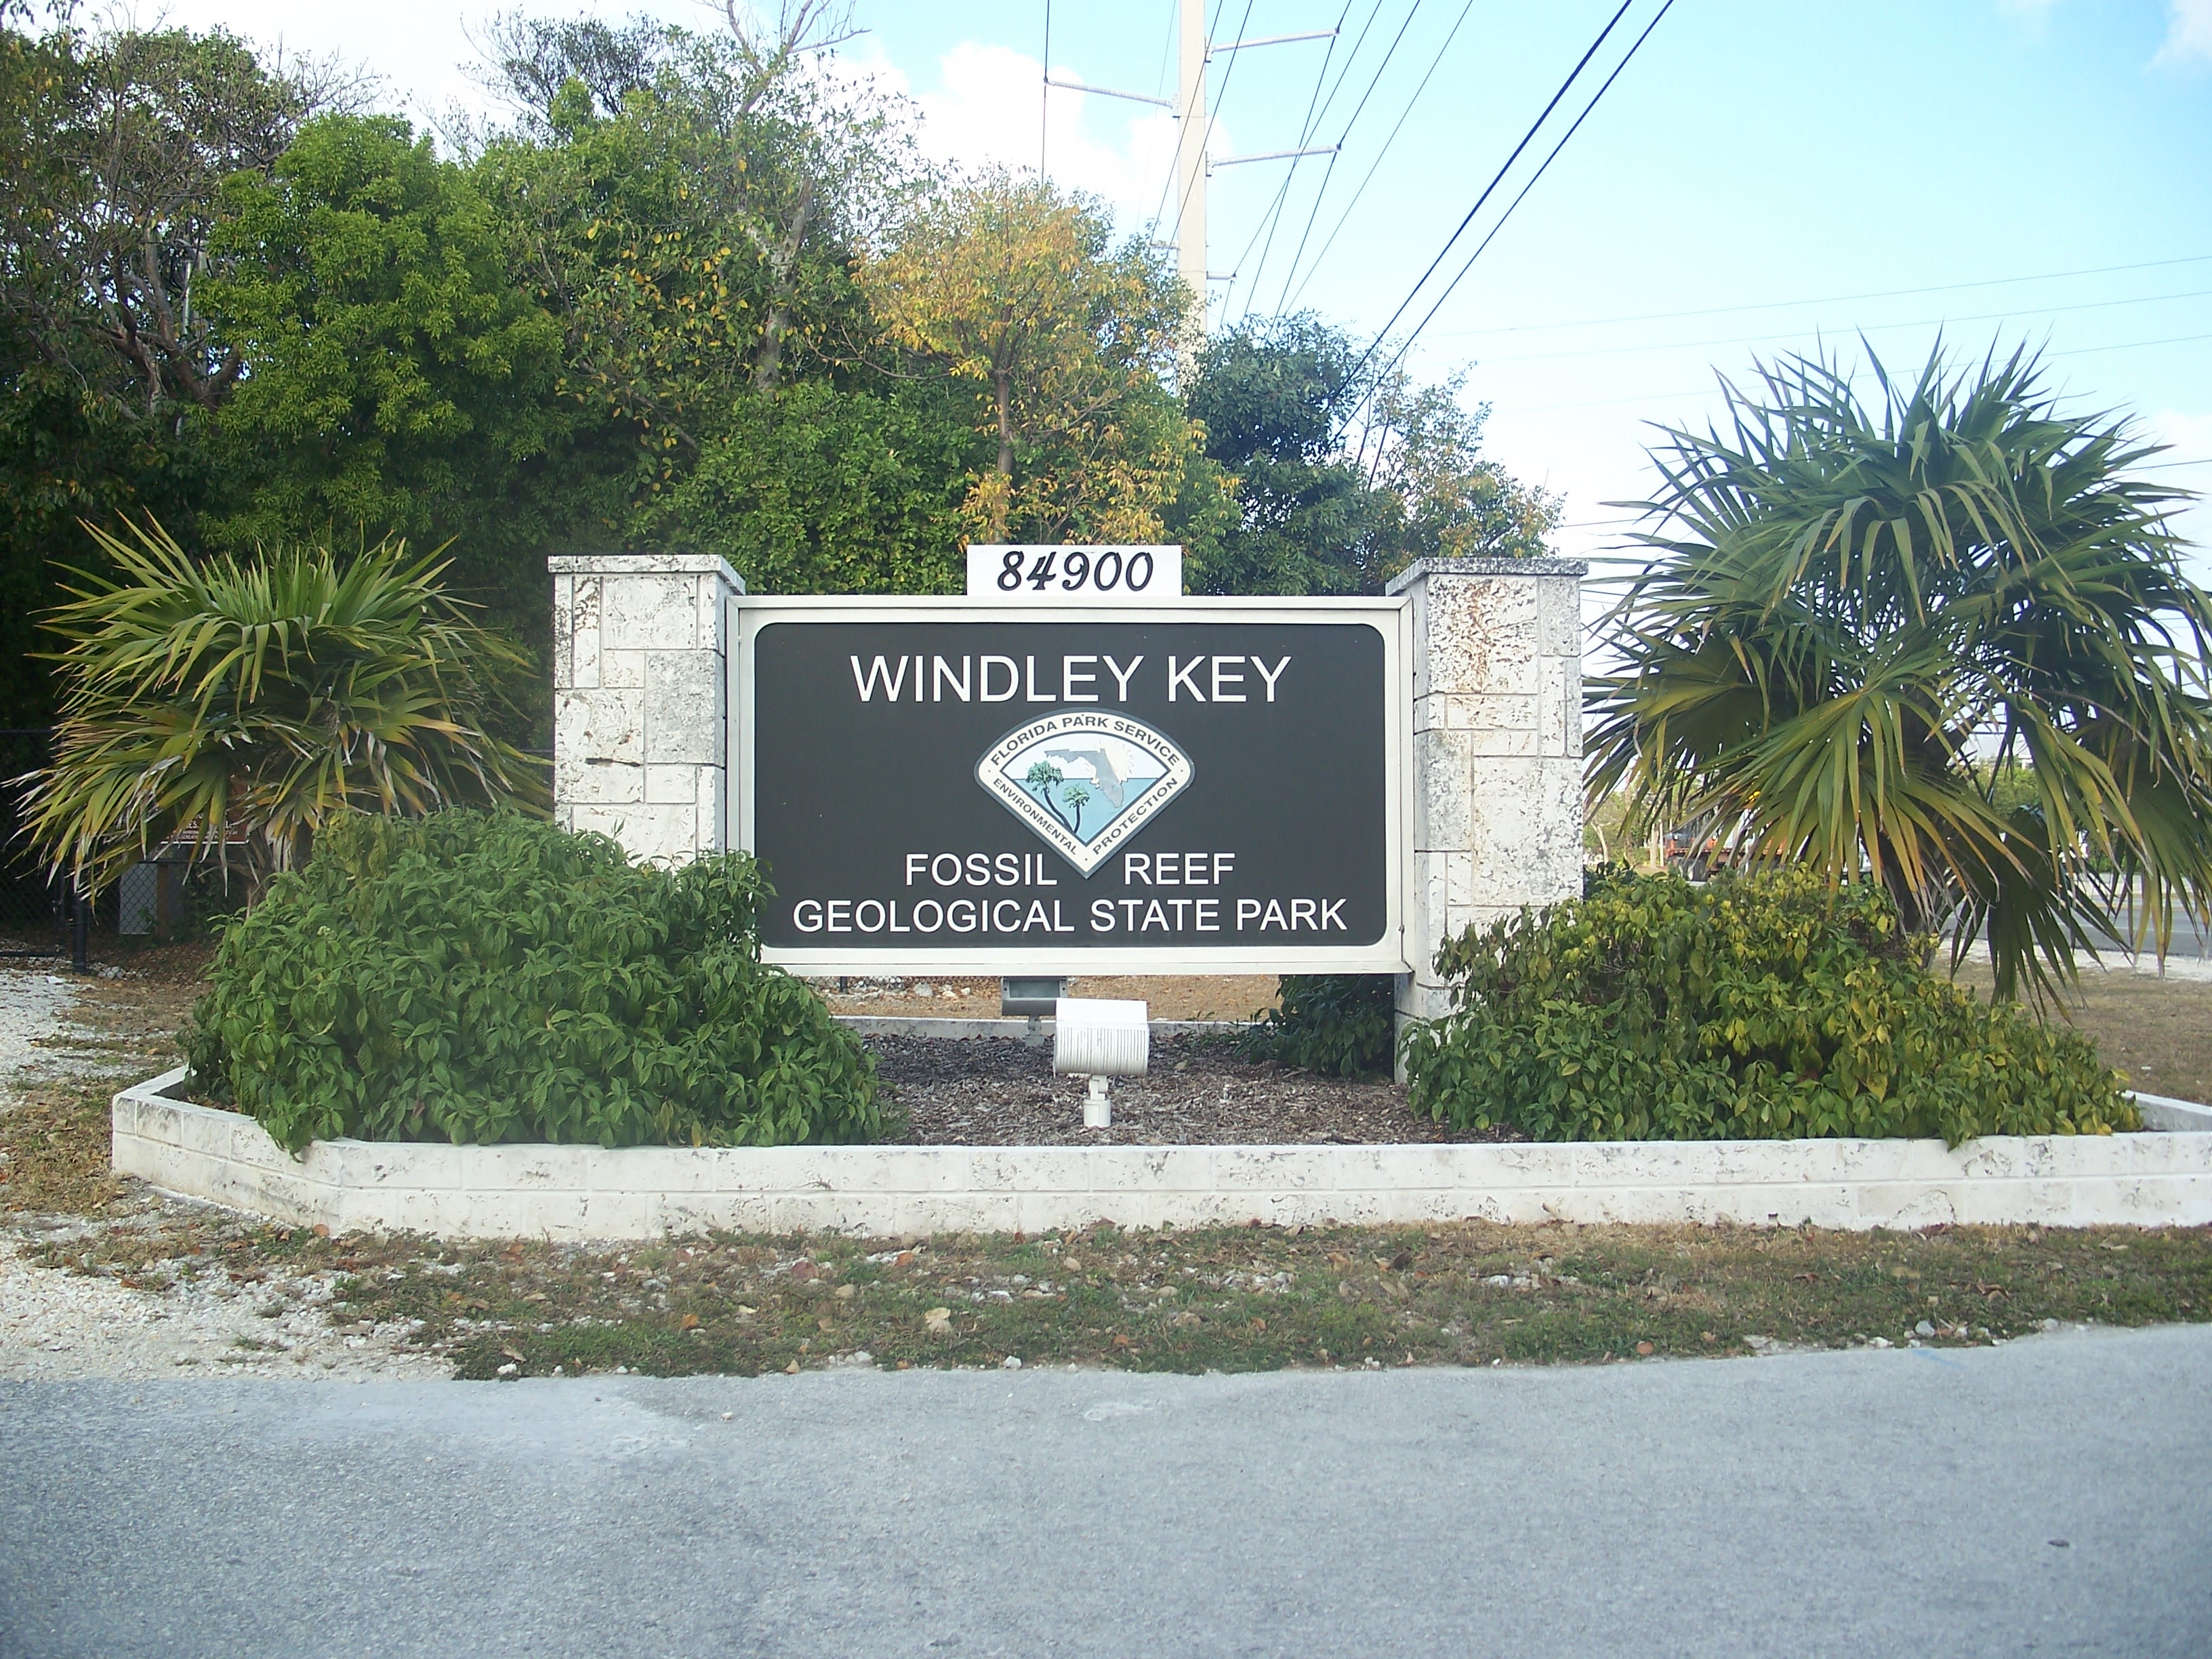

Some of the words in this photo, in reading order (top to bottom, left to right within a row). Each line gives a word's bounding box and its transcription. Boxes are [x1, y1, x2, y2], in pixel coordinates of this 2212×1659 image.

[997, 550, 1153, 592] 84900
[850, 655, 1145, 703] WINDLEY
[1168, 655, 1292, 703] KEY
[991, 721, 1057, 766] FLORIDA
[1062, 716, 1109, 728] PARK
[1113, 720, 1180, 766] SERVICE
[993, 778, 1078, 856] ENVIRONMENTAL
[1092, 777, 1179, 855] PROTECTION
[905, 853, 1058, 886] FOSSIL
[1124, 853, 1236, 886] REEF
[792, 899, 1076, 933] GEOLOGICAL
[1089, 898, 1221, 933] STATE
[1236, 898, 1348, 932] PARK
